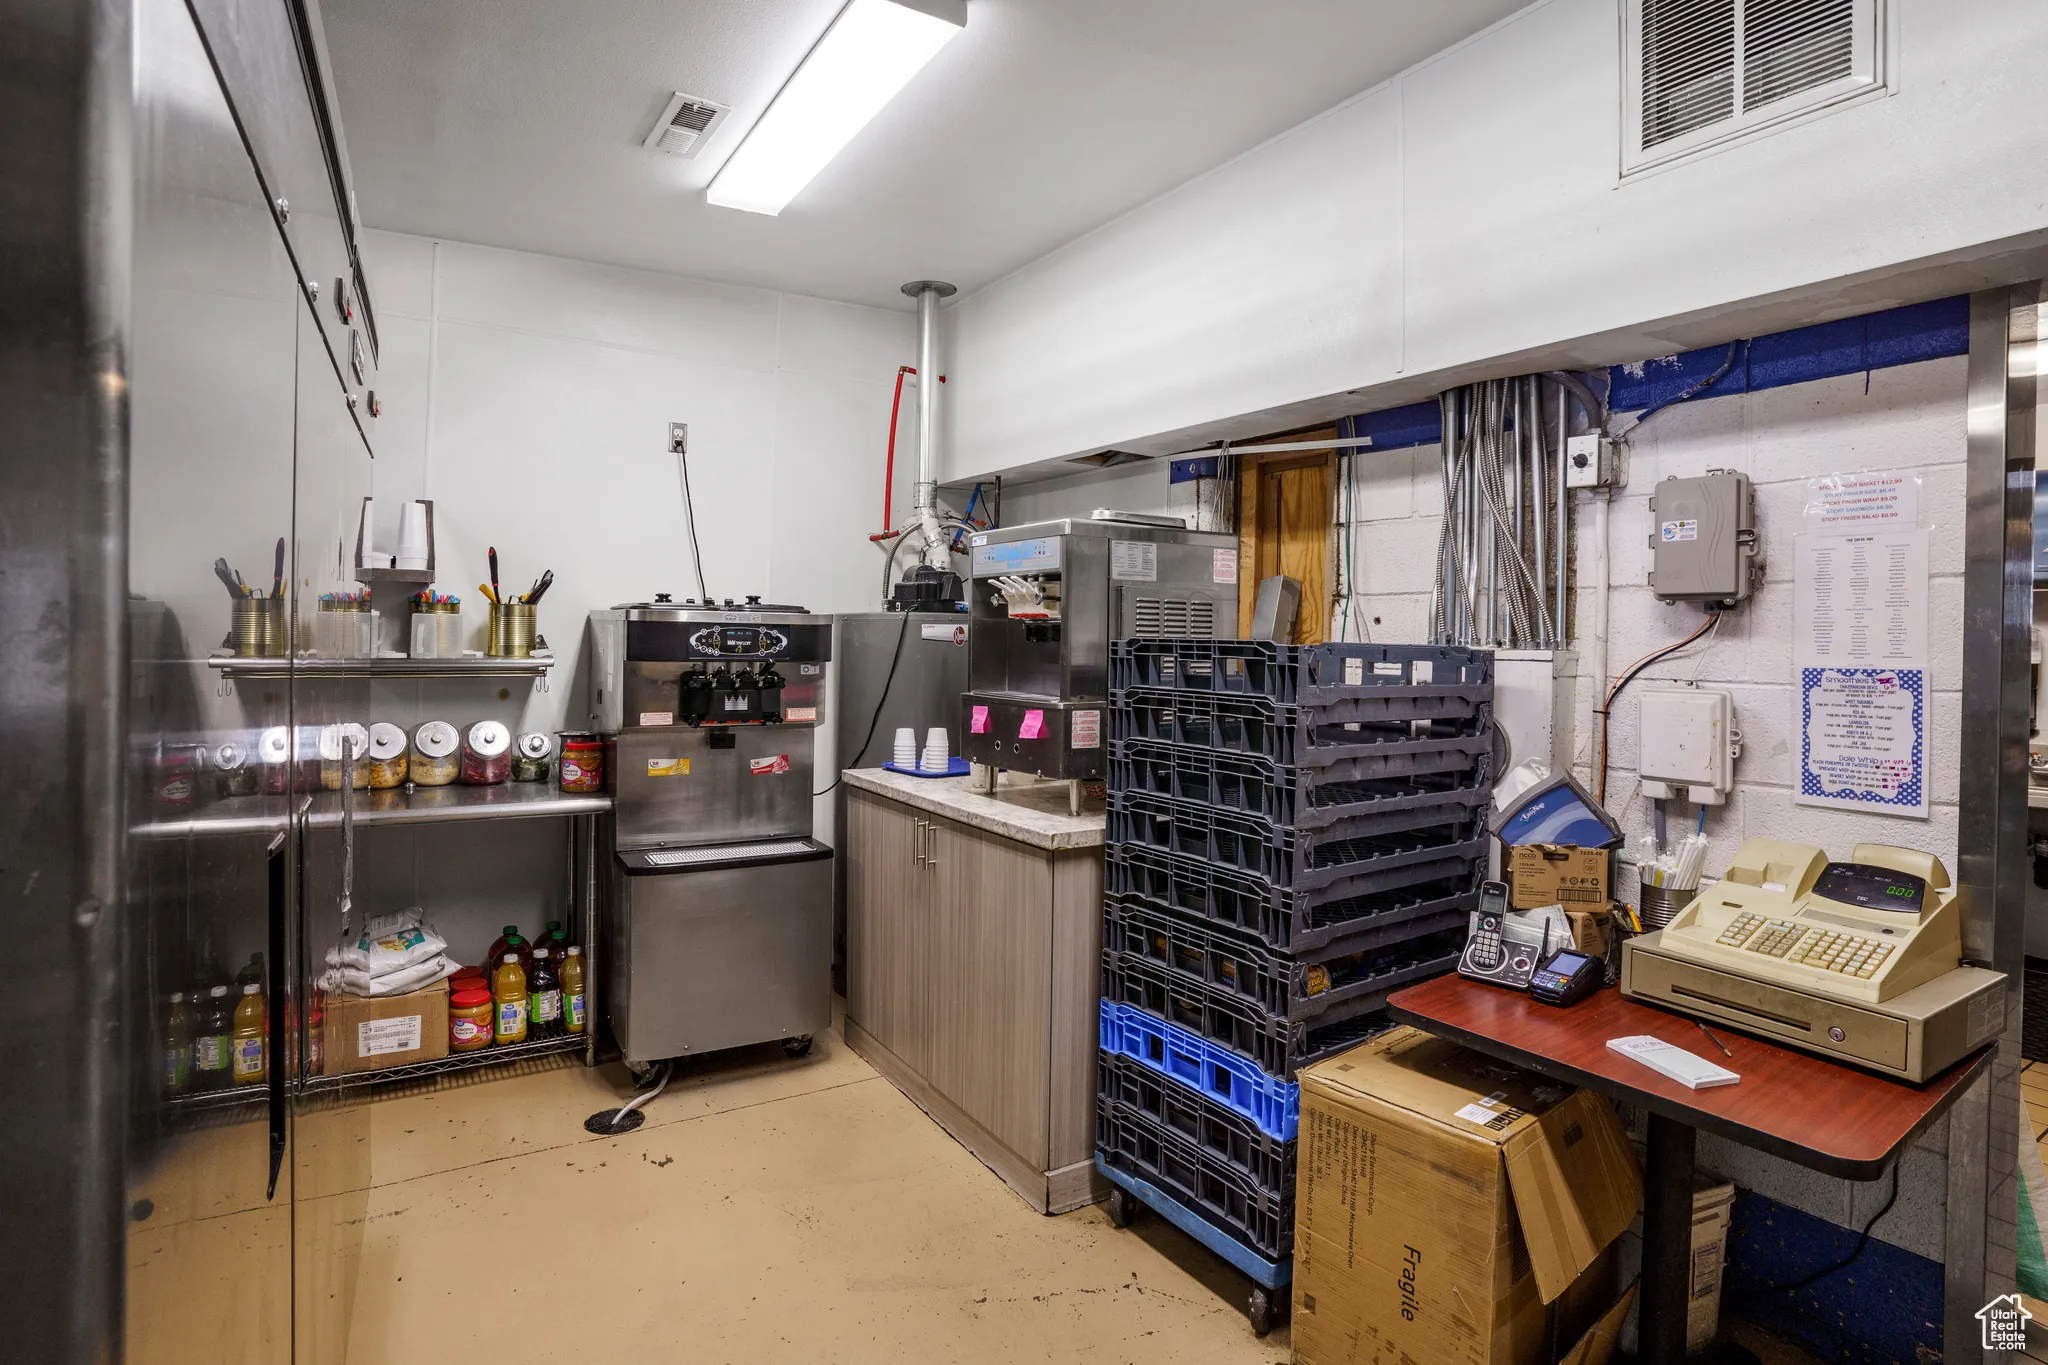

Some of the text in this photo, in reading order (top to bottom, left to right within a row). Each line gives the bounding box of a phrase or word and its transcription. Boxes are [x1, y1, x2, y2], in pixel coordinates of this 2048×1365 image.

[1857, 756, 1879, 765] Whip
[1521, 802, 1545, 821] EasyNap
[1886, 886, 1915, 898] 0.00
[1342, 1121, 1350, 1150] Country
[1343, 1151, 1348, 1159] of
[1367, 1132, 1377, 1216] Sharp Electronics Corp.
[1348, 1212, 1356, 1250] Microwave
[1398, 1244, 1421, 1322] Fragile
